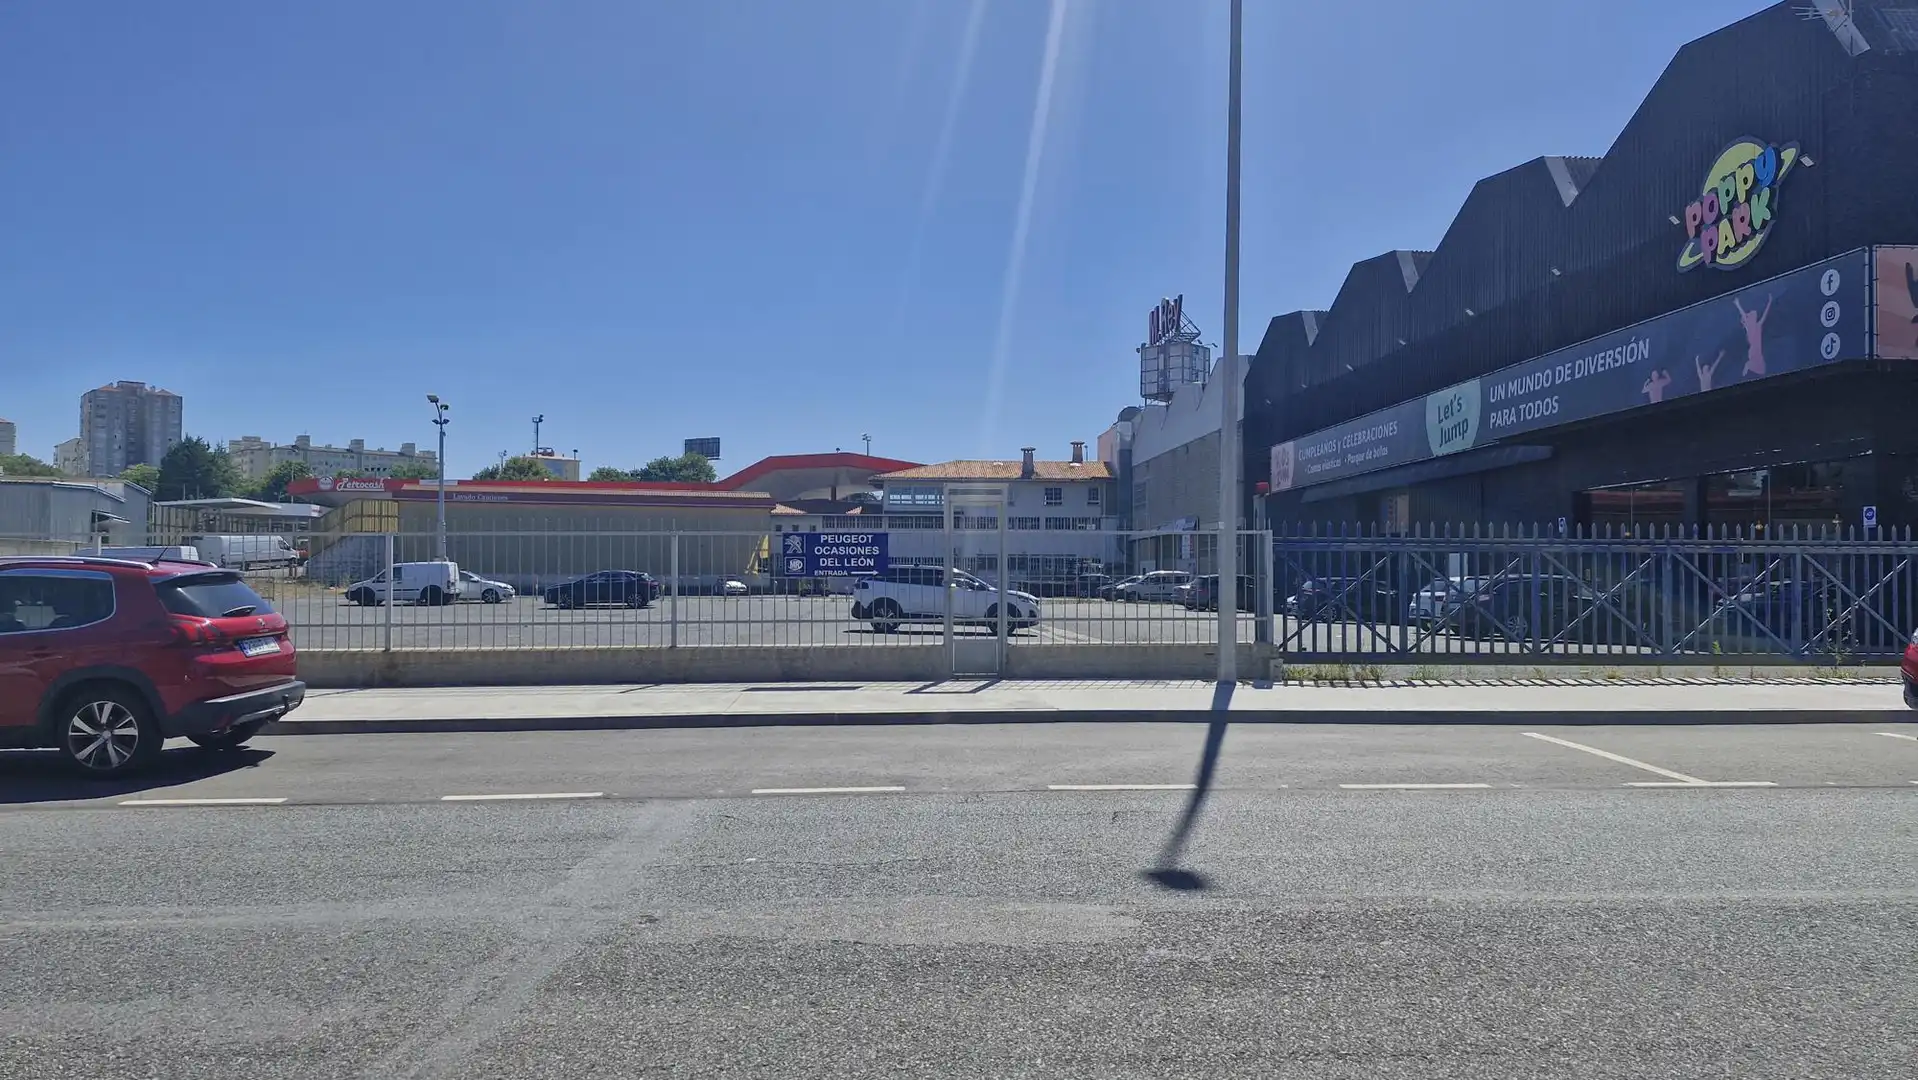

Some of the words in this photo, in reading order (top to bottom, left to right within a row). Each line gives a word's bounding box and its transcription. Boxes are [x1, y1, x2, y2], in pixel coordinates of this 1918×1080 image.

[1685, 146, 1776, 239] POPPY
[1701, 187, 1771, 265] PARK
[1490, 384, 1506, 403] UN
[1508, 370, 1551, 398] MUNDO
[1555, 362, 1572, 384] DE
[1574, 336, 1650, 379] DIVERSIÓN
[1437, 394, 1463, 424] Let's
[1490, 409, 1517, 430] PARA
[1519, 395, 1560, 420] TODOS
[1439, 416, 1469, 448] Jump
[814, 546, 880, 555] OCASIONES
[820, 534, 874, 544] PEUGEOT
[820, 557, 842, 567] DEL
[844, 556, 874, 567] LEÓN
